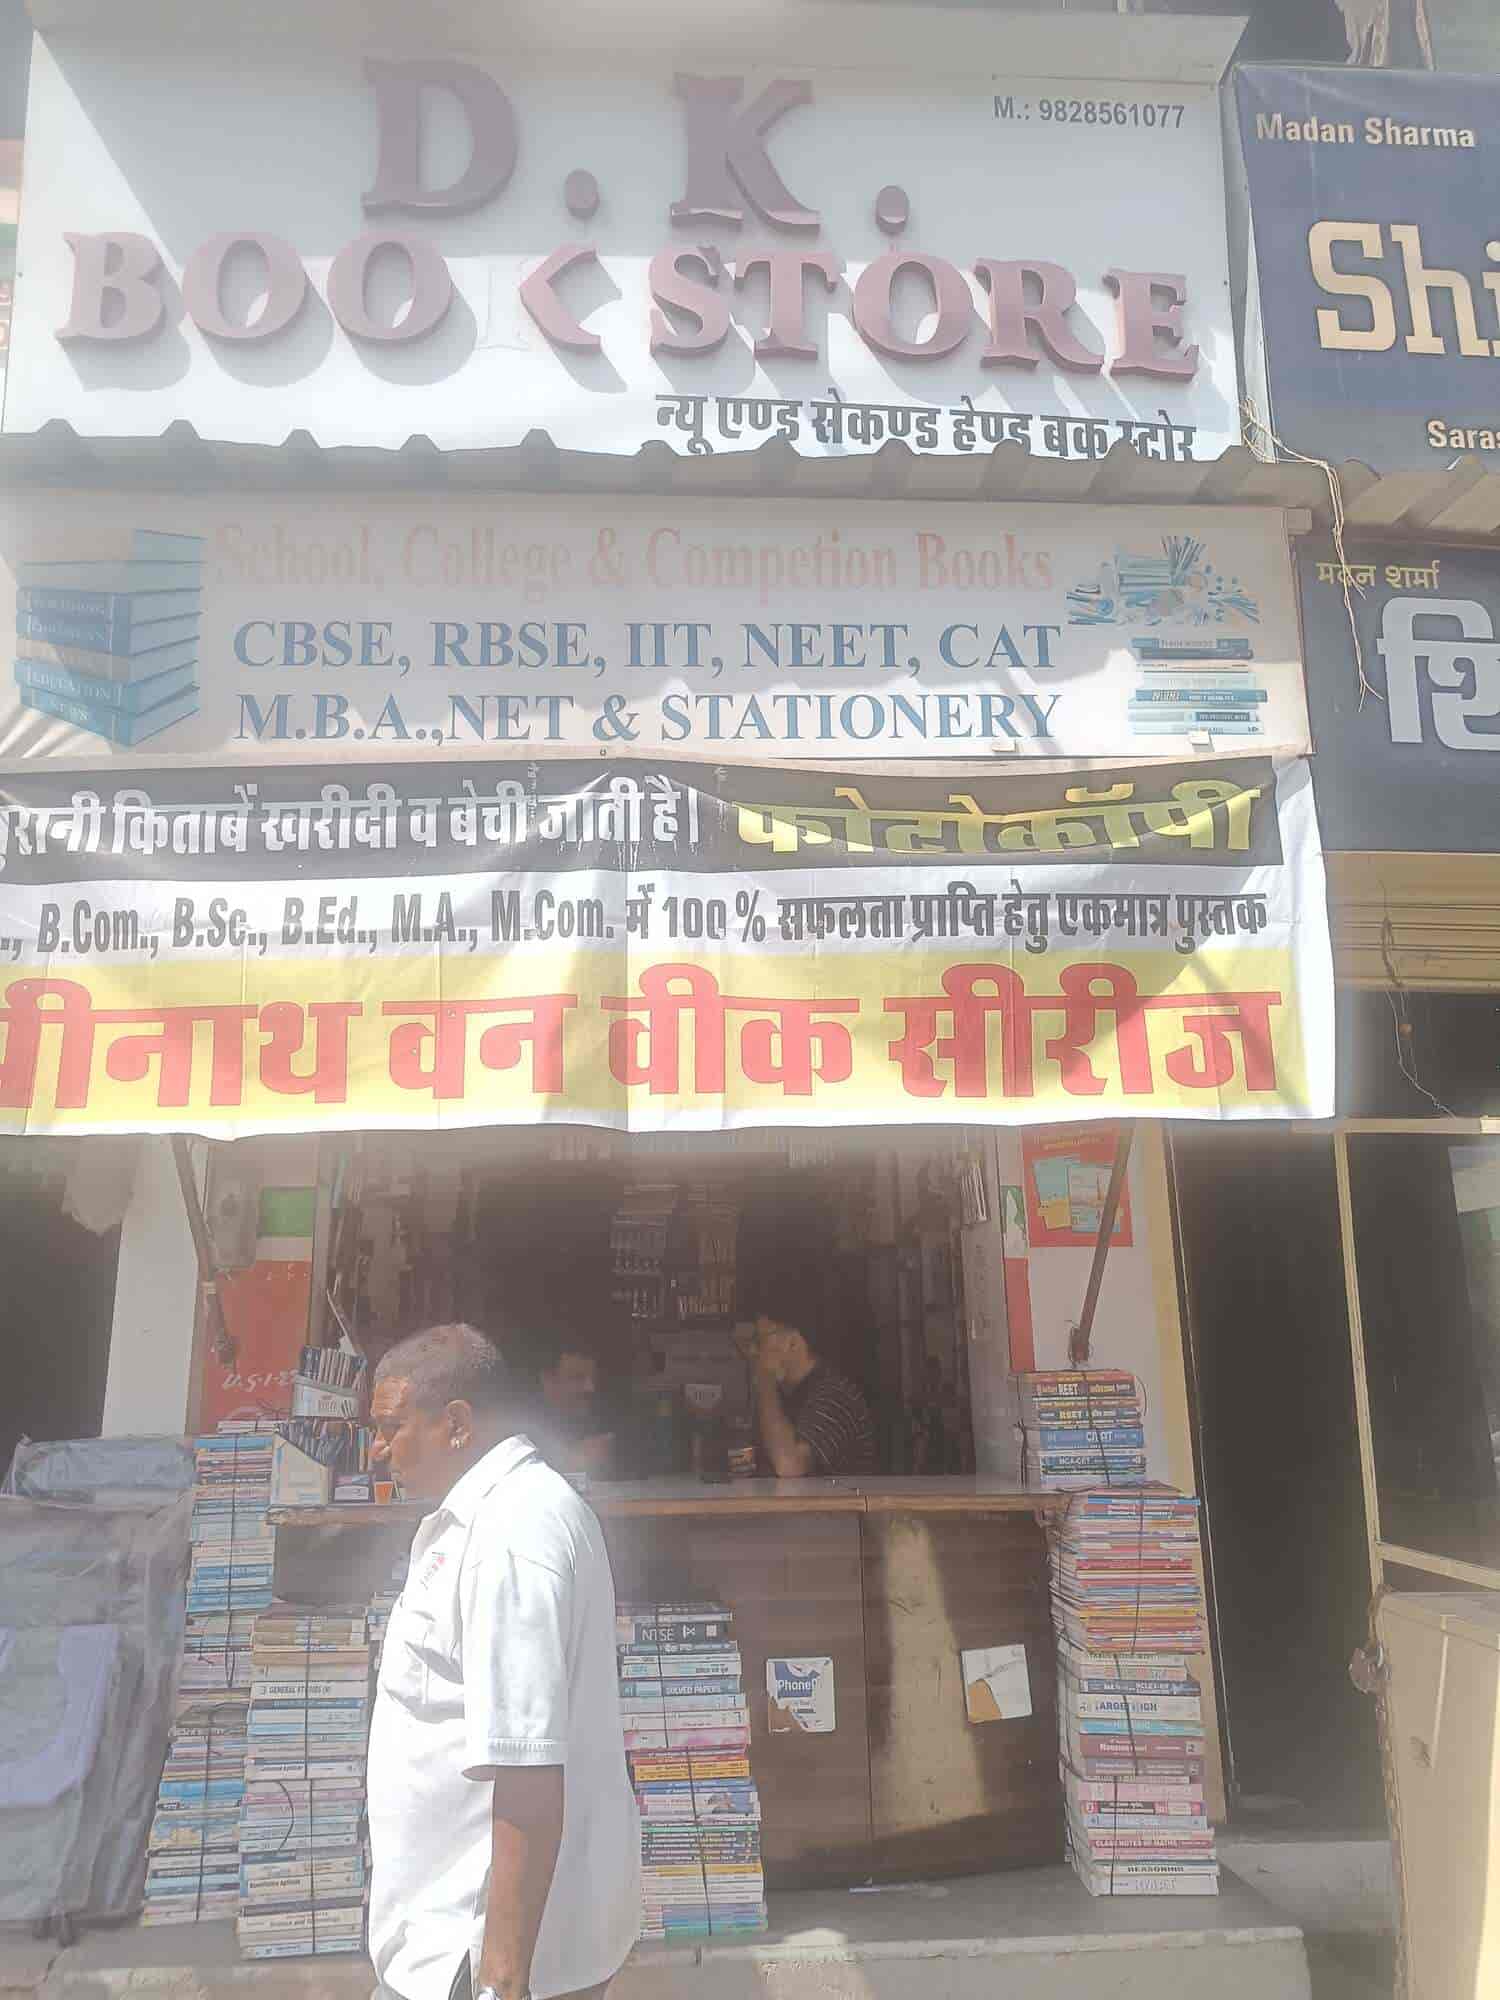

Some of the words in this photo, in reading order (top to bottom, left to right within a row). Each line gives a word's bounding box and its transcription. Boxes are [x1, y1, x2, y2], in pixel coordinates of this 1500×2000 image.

[1039, 98, 1186, 129] 9828561077
[1255, 113, 1355, 145] Madan
[1365, 117, 1476, 148] Sharma
[648, 243, 1201, 383] STORE
[402, 523, 573, 605] College
[914, 531, 1056, 592] Books
[1385, 560, 1441, 590] शर्मा
[232, 620, 411, 679] CBSE,
[429, 620, 608, 679] RBSE,
[623, 622, 724, 679] IIT,
[741, 622, 921, 679] NEET,
[938, 622, 1062, 669] CAT
[591, 692, 641, 743] &
[660, 692, 1064, 741] STATIONERY
[112, 783, 258, 854] किताबें
[732, 778, 1261, 852] फोटोकॉपी
[776, 896, 906, 942] सफलता
[383, 994, 577, 1099] वन
[882, 962, 1282, 1098] सीरीज
